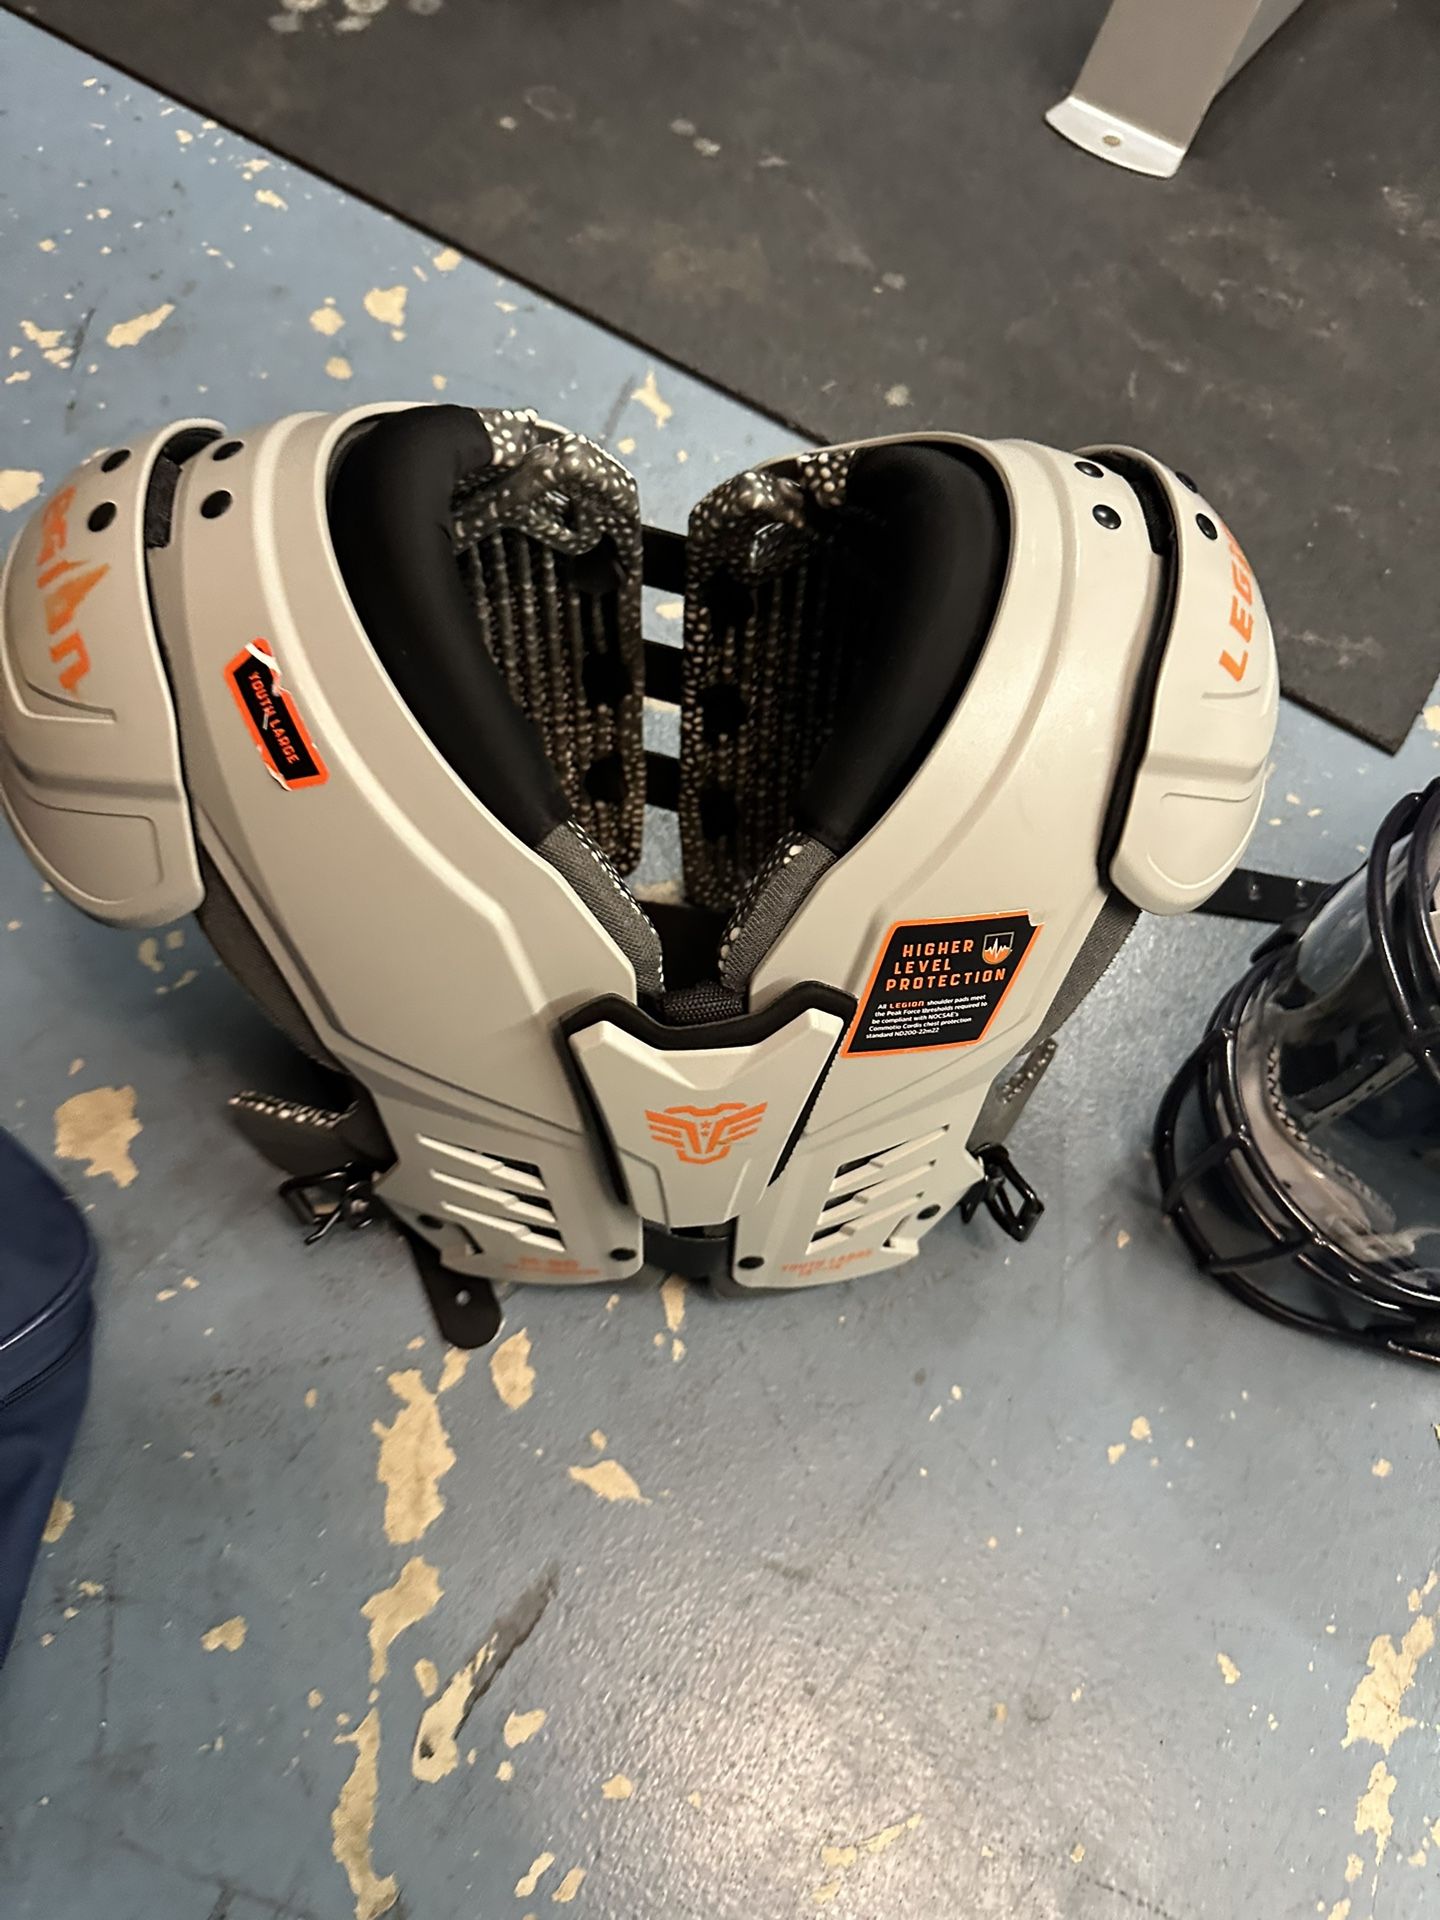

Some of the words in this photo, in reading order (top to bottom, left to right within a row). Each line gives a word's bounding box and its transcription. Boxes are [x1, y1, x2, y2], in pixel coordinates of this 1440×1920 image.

[248, 671, 277, 717] YOUTH
[269, 719, 300, 765] LARGE
[902, 939, 975, 958] HIGHER
[894, 958, 951, 975] LEVEL
[885, 968, 1006, 992] PROTECTION
[921, 1005, 954, 1014] thresholds
[954, 1002, 980, 1011] required
[926, 998, 954, 1006] shoulder
[954, 996, 970, 1004] pads
[868, 1024, 901, 1032] Commotio
[902, 1021, 922, 1029] Cordis
[940, 1017, 972, 1027] protection
[881, 1016, 912, 1025] compliant
[913, 1013, 927, 1021] with
[928, 1011, 959, 1020] NOCSAE's
[866, 1031, 894, 1039] standard
